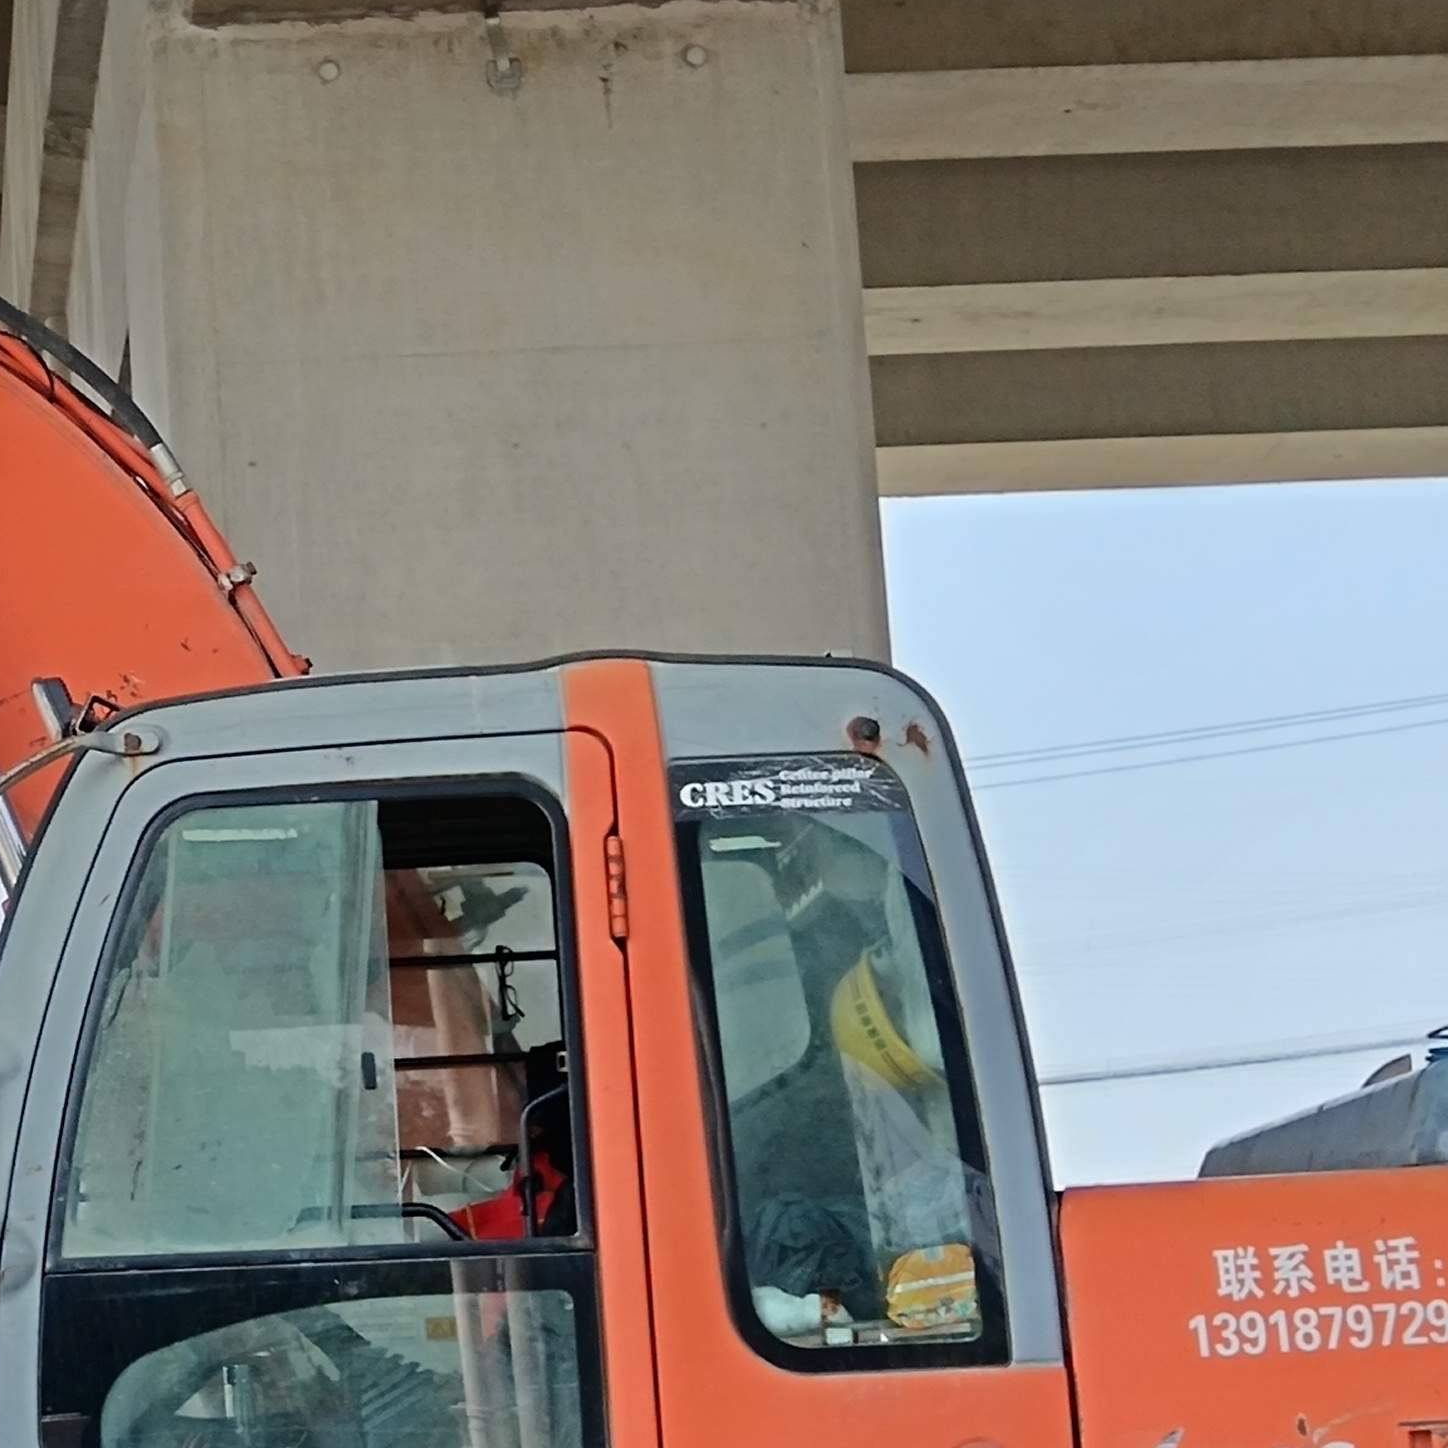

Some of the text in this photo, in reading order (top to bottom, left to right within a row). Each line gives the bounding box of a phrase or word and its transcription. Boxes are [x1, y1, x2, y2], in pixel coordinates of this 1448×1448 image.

[680, 780, 776, 808] CRES
[780, 781, 861, 795] Reinforced
[780, 796, 852, 808] Structure
[1212, 1236, 1446, 1300] 联系电话：
